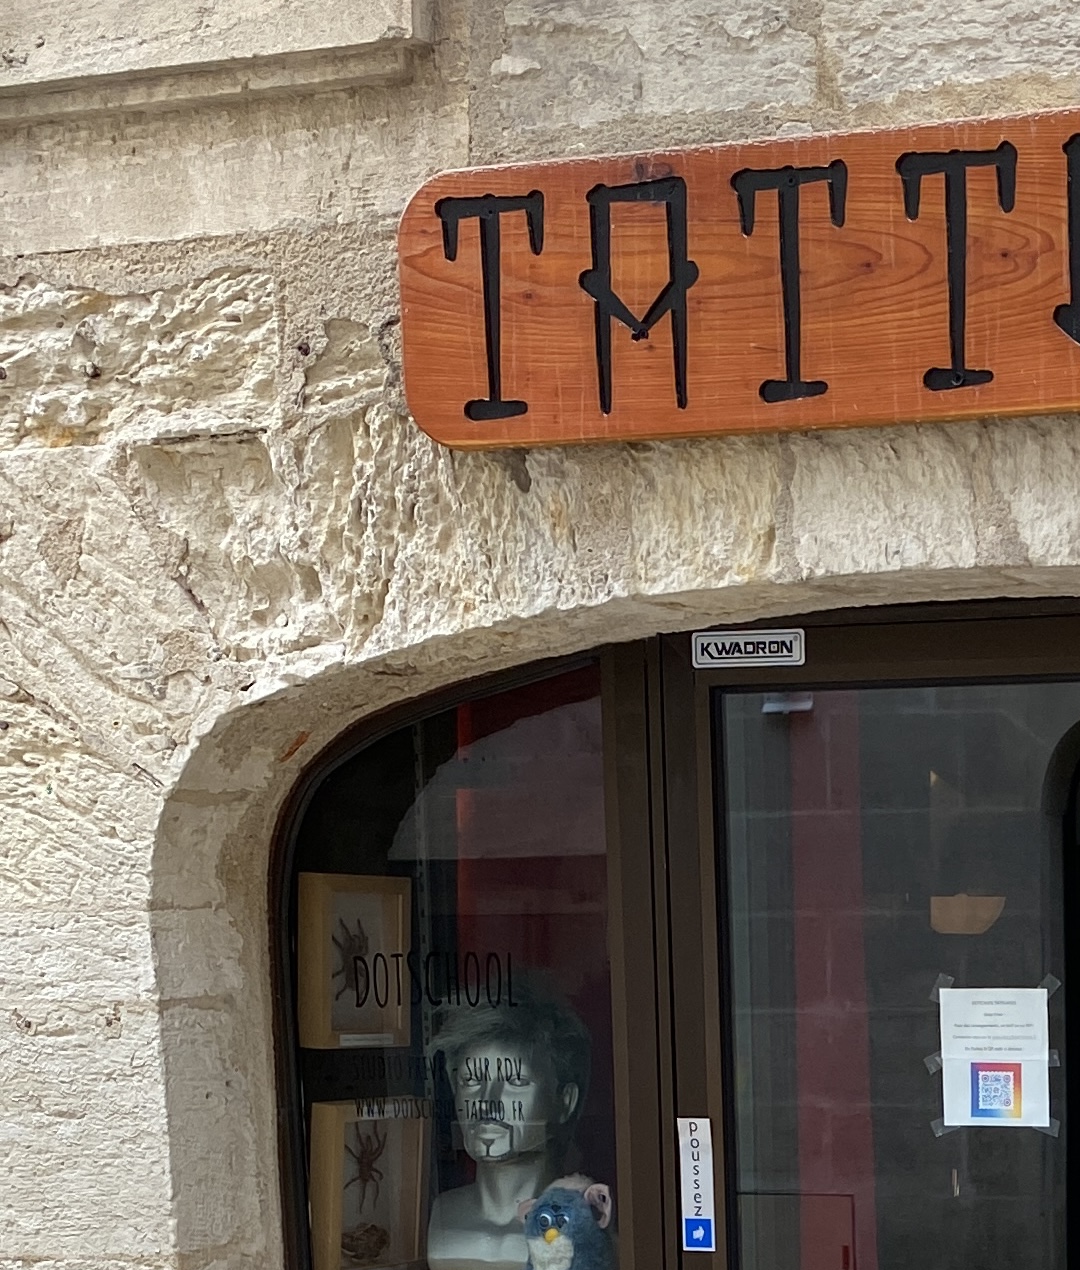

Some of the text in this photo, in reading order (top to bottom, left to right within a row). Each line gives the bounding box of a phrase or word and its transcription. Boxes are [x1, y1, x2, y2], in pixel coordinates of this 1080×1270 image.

[700, 640, 793, 659] KWADRON
[353, 952, 518, 1008] DOTSCHOOL
[465, 1057, 492, 1081] SUR
[496, 1057, 522, 1081] RDV
